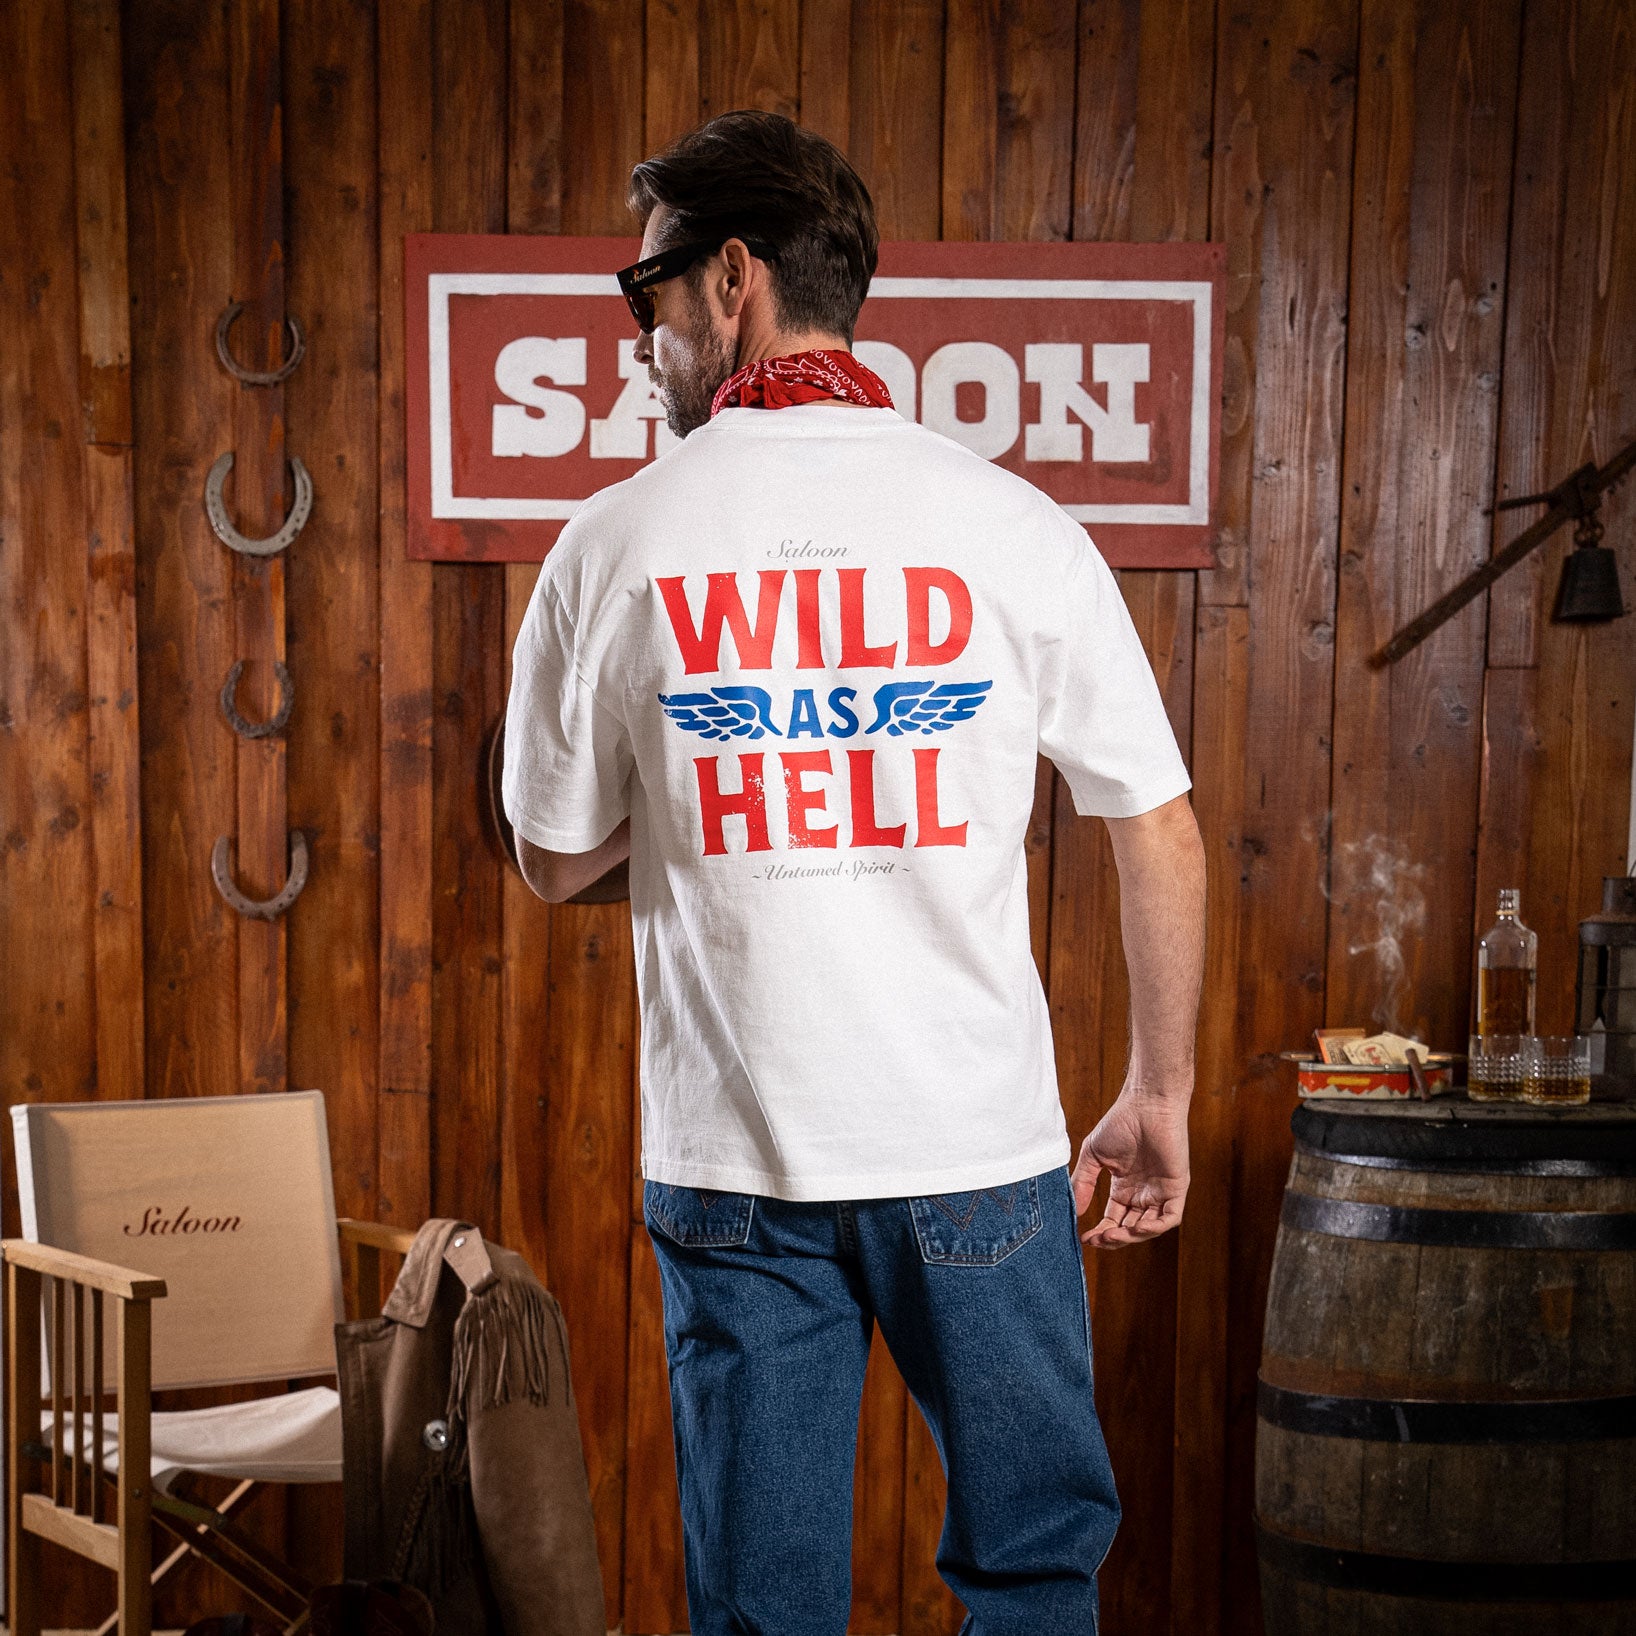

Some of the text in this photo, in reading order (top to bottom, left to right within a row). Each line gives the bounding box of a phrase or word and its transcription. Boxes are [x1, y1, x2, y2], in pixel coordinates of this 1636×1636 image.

[491, 336, 1151, 463] SAON
[766, 539, 849, 559] Saloon
[655, 567, 973, 675] WILD
[786, 686, 860, 739] AS
[693, 748, 969, 857] HELL
[764, 861, 843, 880] Untamed
[845, 860, 896, 881] Spirit
[123, 1205, 242, 1237] Saloon
